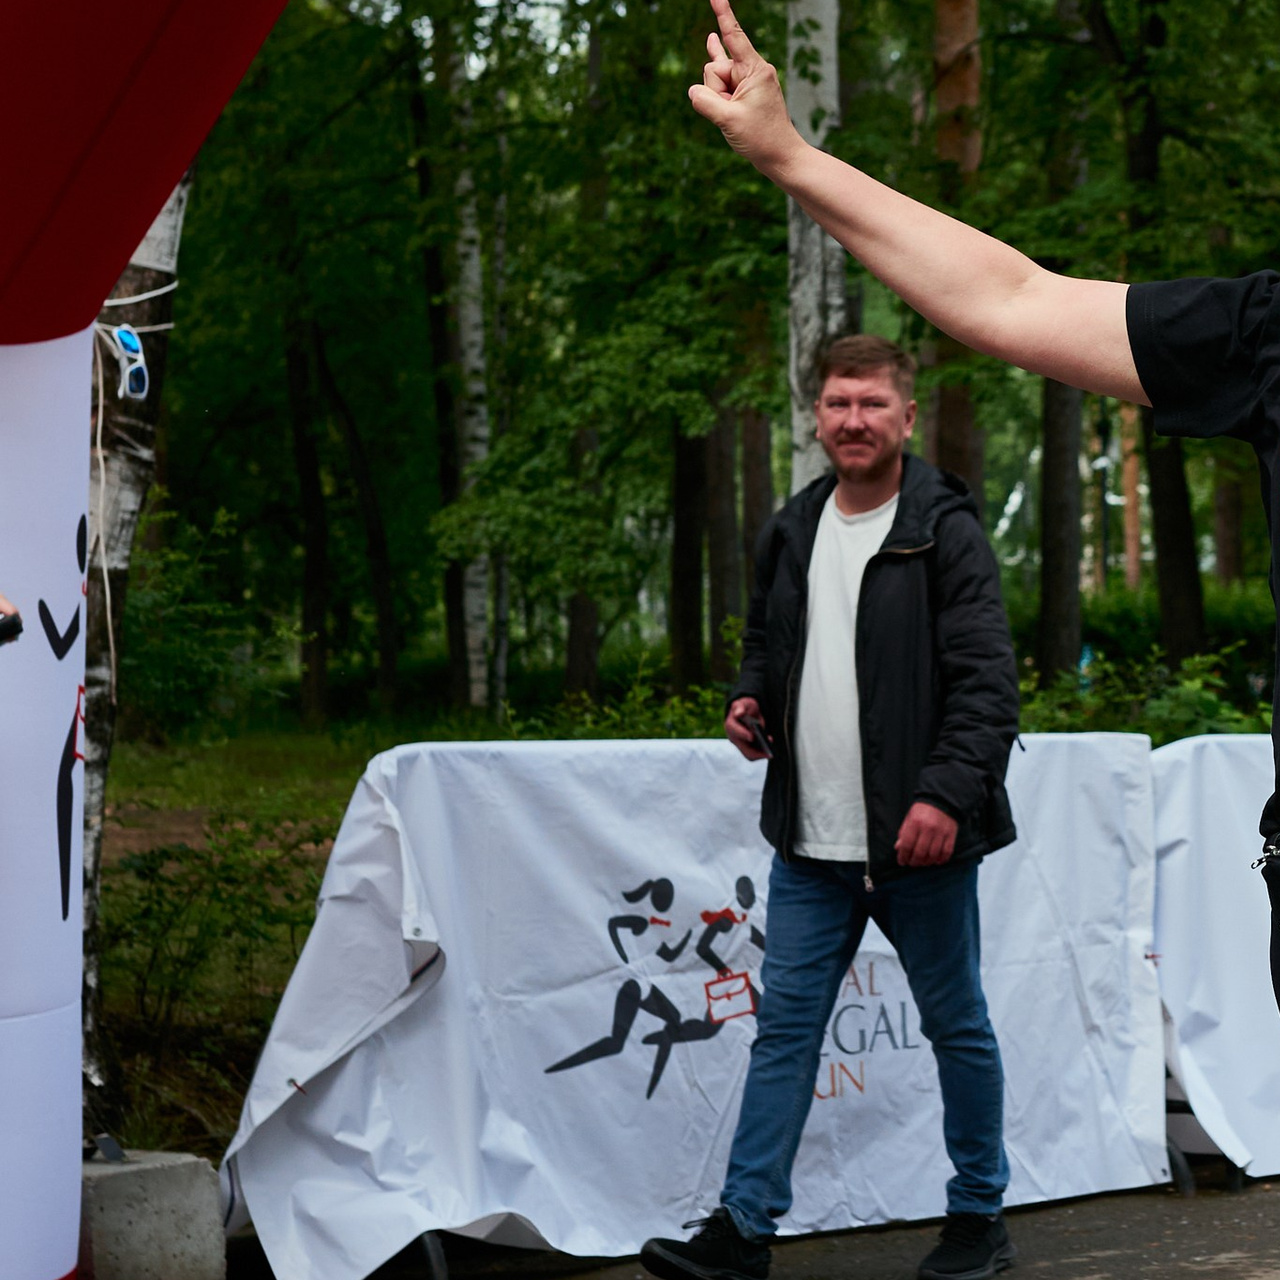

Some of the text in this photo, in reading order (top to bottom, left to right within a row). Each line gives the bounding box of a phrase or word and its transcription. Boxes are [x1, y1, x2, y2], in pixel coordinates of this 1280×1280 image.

[841, 961, 883, 999] AL
[820, 1001, 921, 1057] GAL
[813, 1060, 866, 1101] UN
